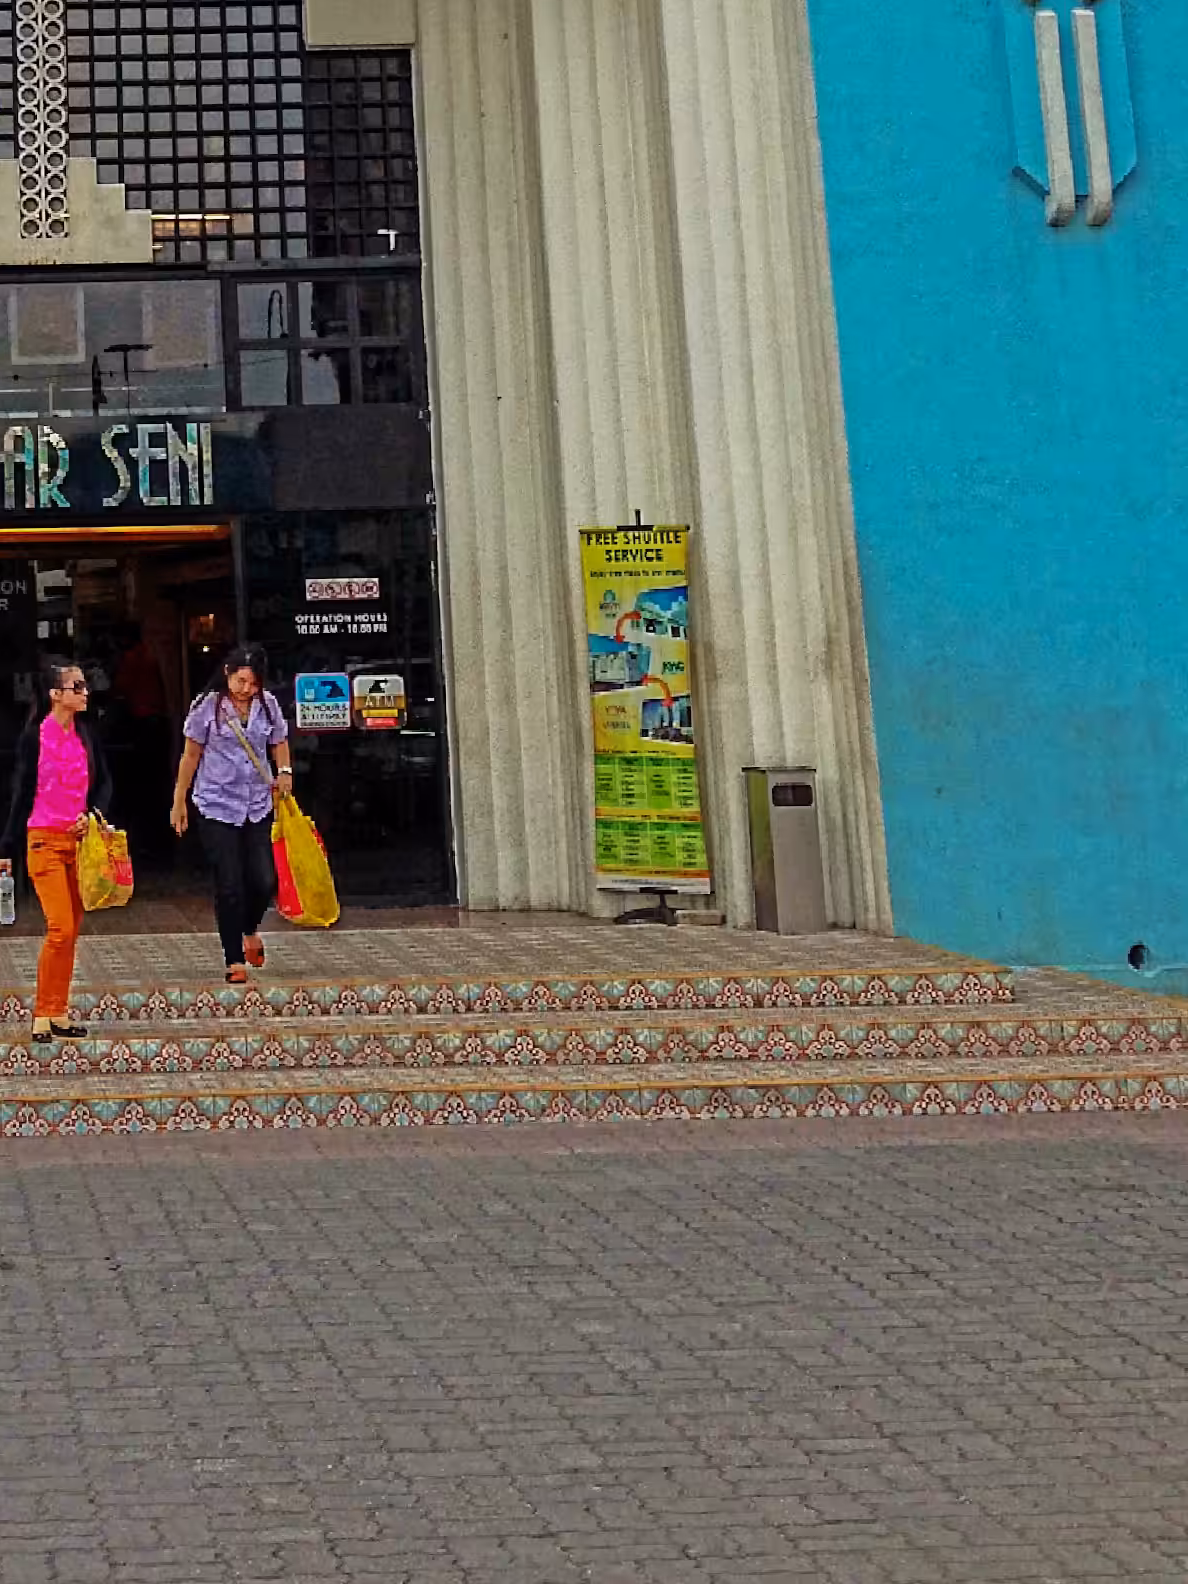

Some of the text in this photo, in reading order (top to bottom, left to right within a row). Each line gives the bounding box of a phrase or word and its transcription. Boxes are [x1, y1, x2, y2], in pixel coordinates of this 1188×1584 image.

[100, 422, 214, 507] SENI
[586, 531, 682, 546] FREE SHUTTLE
[605, 548, 664, 563] SERVICE
[294, 612, 388, 624] OPERATION HOURS
[322, 624, 338, 634] AM
[364, 695, 396, 708] ATM
